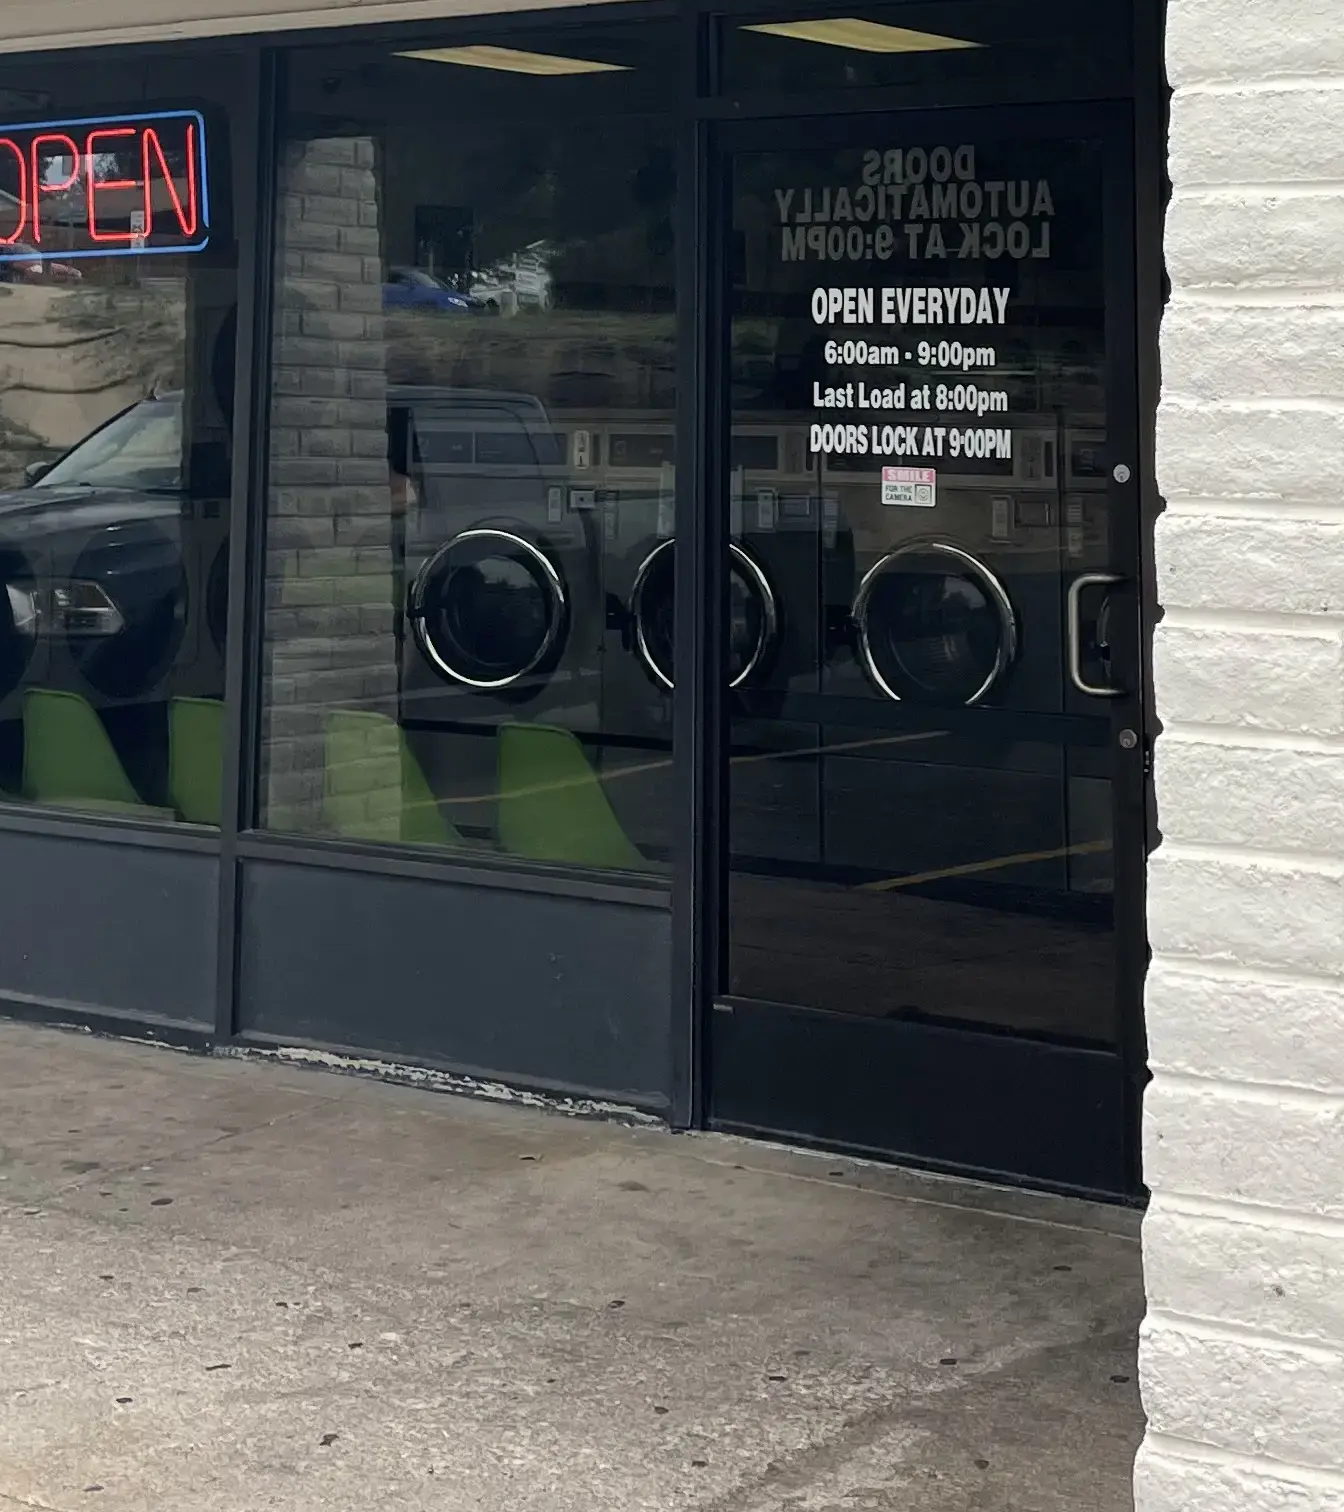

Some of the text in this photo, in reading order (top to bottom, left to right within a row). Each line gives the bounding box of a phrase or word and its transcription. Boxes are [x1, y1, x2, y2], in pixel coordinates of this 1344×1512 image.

[811, 287, 1010, 324] OPEN EVERYDAY
[824, 340, 899, 365] 6:00am
[917, 341, 996, 371] 9:00pm
[813, 381, 1008, 417] Last Load at 8:00pm
[810, 424, 869, 454] DOORS
[872, 425, 919, 456] LOCK
[922, 427, 946, 456] AT
[887, 469, 931, 482] SMILE
[885, 493, 913, 501] CAMERA
